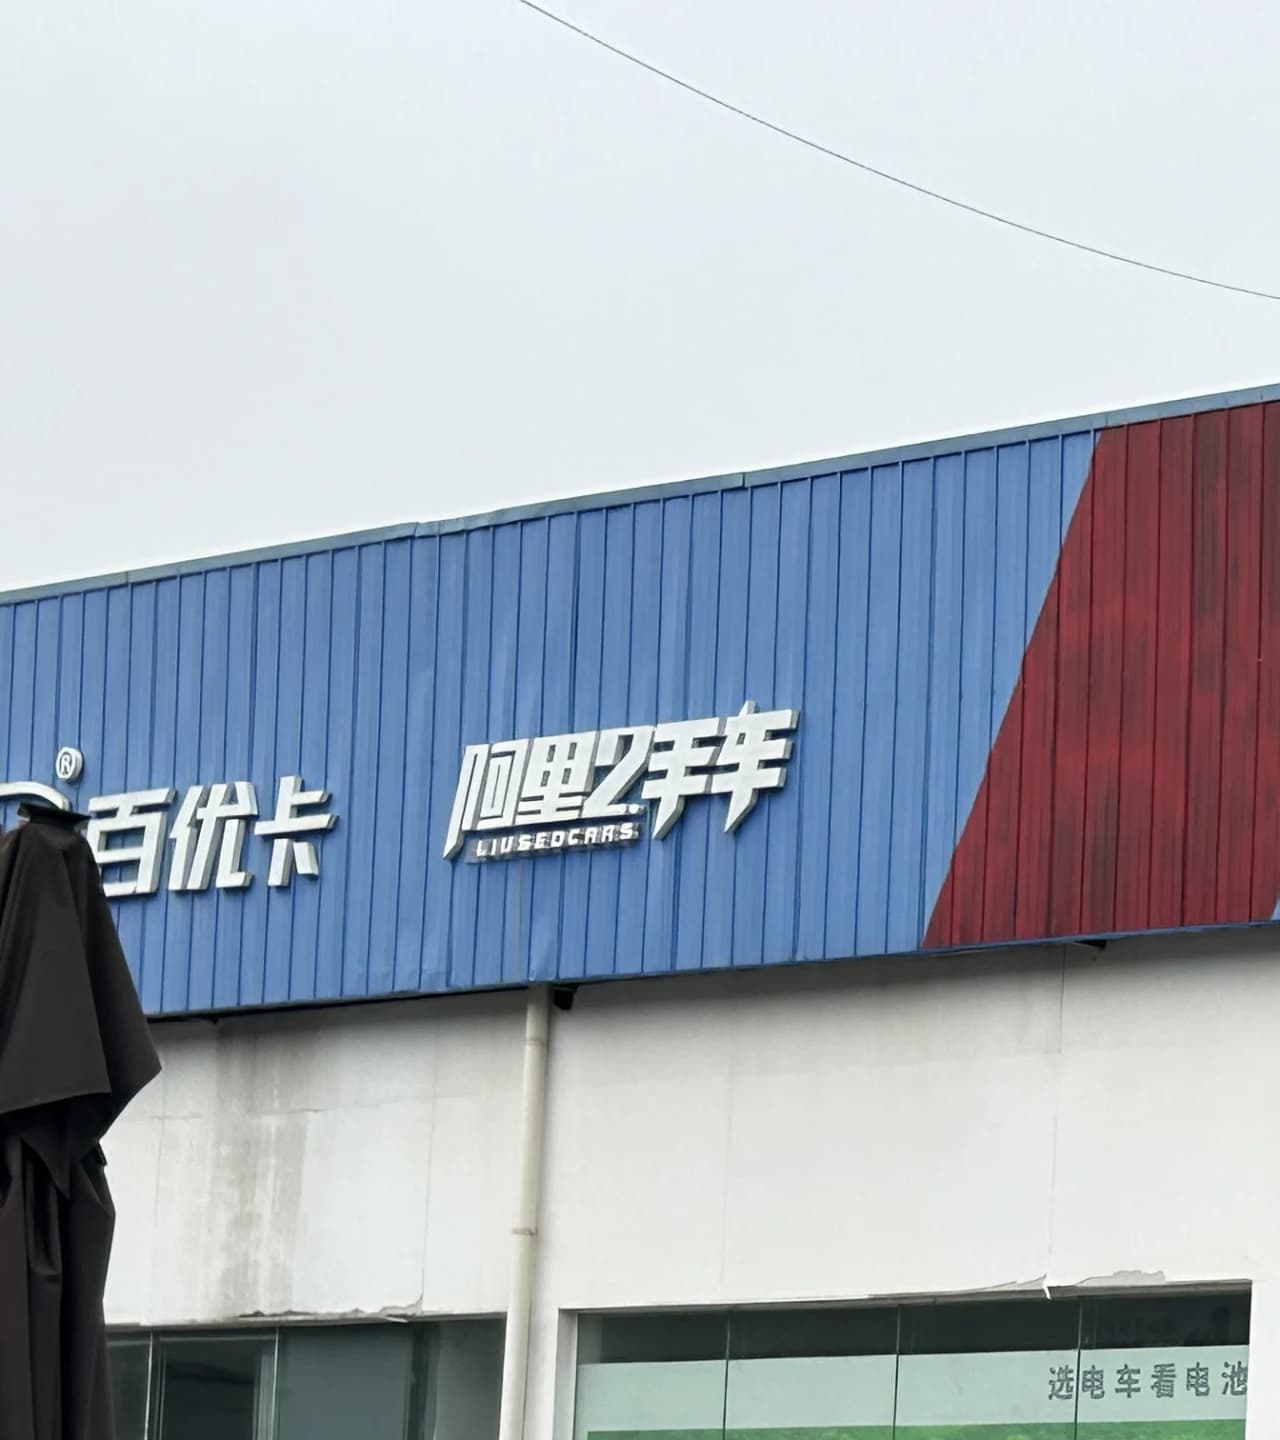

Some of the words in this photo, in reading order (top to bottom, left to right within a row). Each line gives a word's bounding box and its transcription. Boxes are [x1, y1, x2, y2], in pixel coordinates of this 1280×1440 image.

[88, 775, 339, 897] 百优卡
[1048, 1360, 1248, 1401] 选电车看电池
